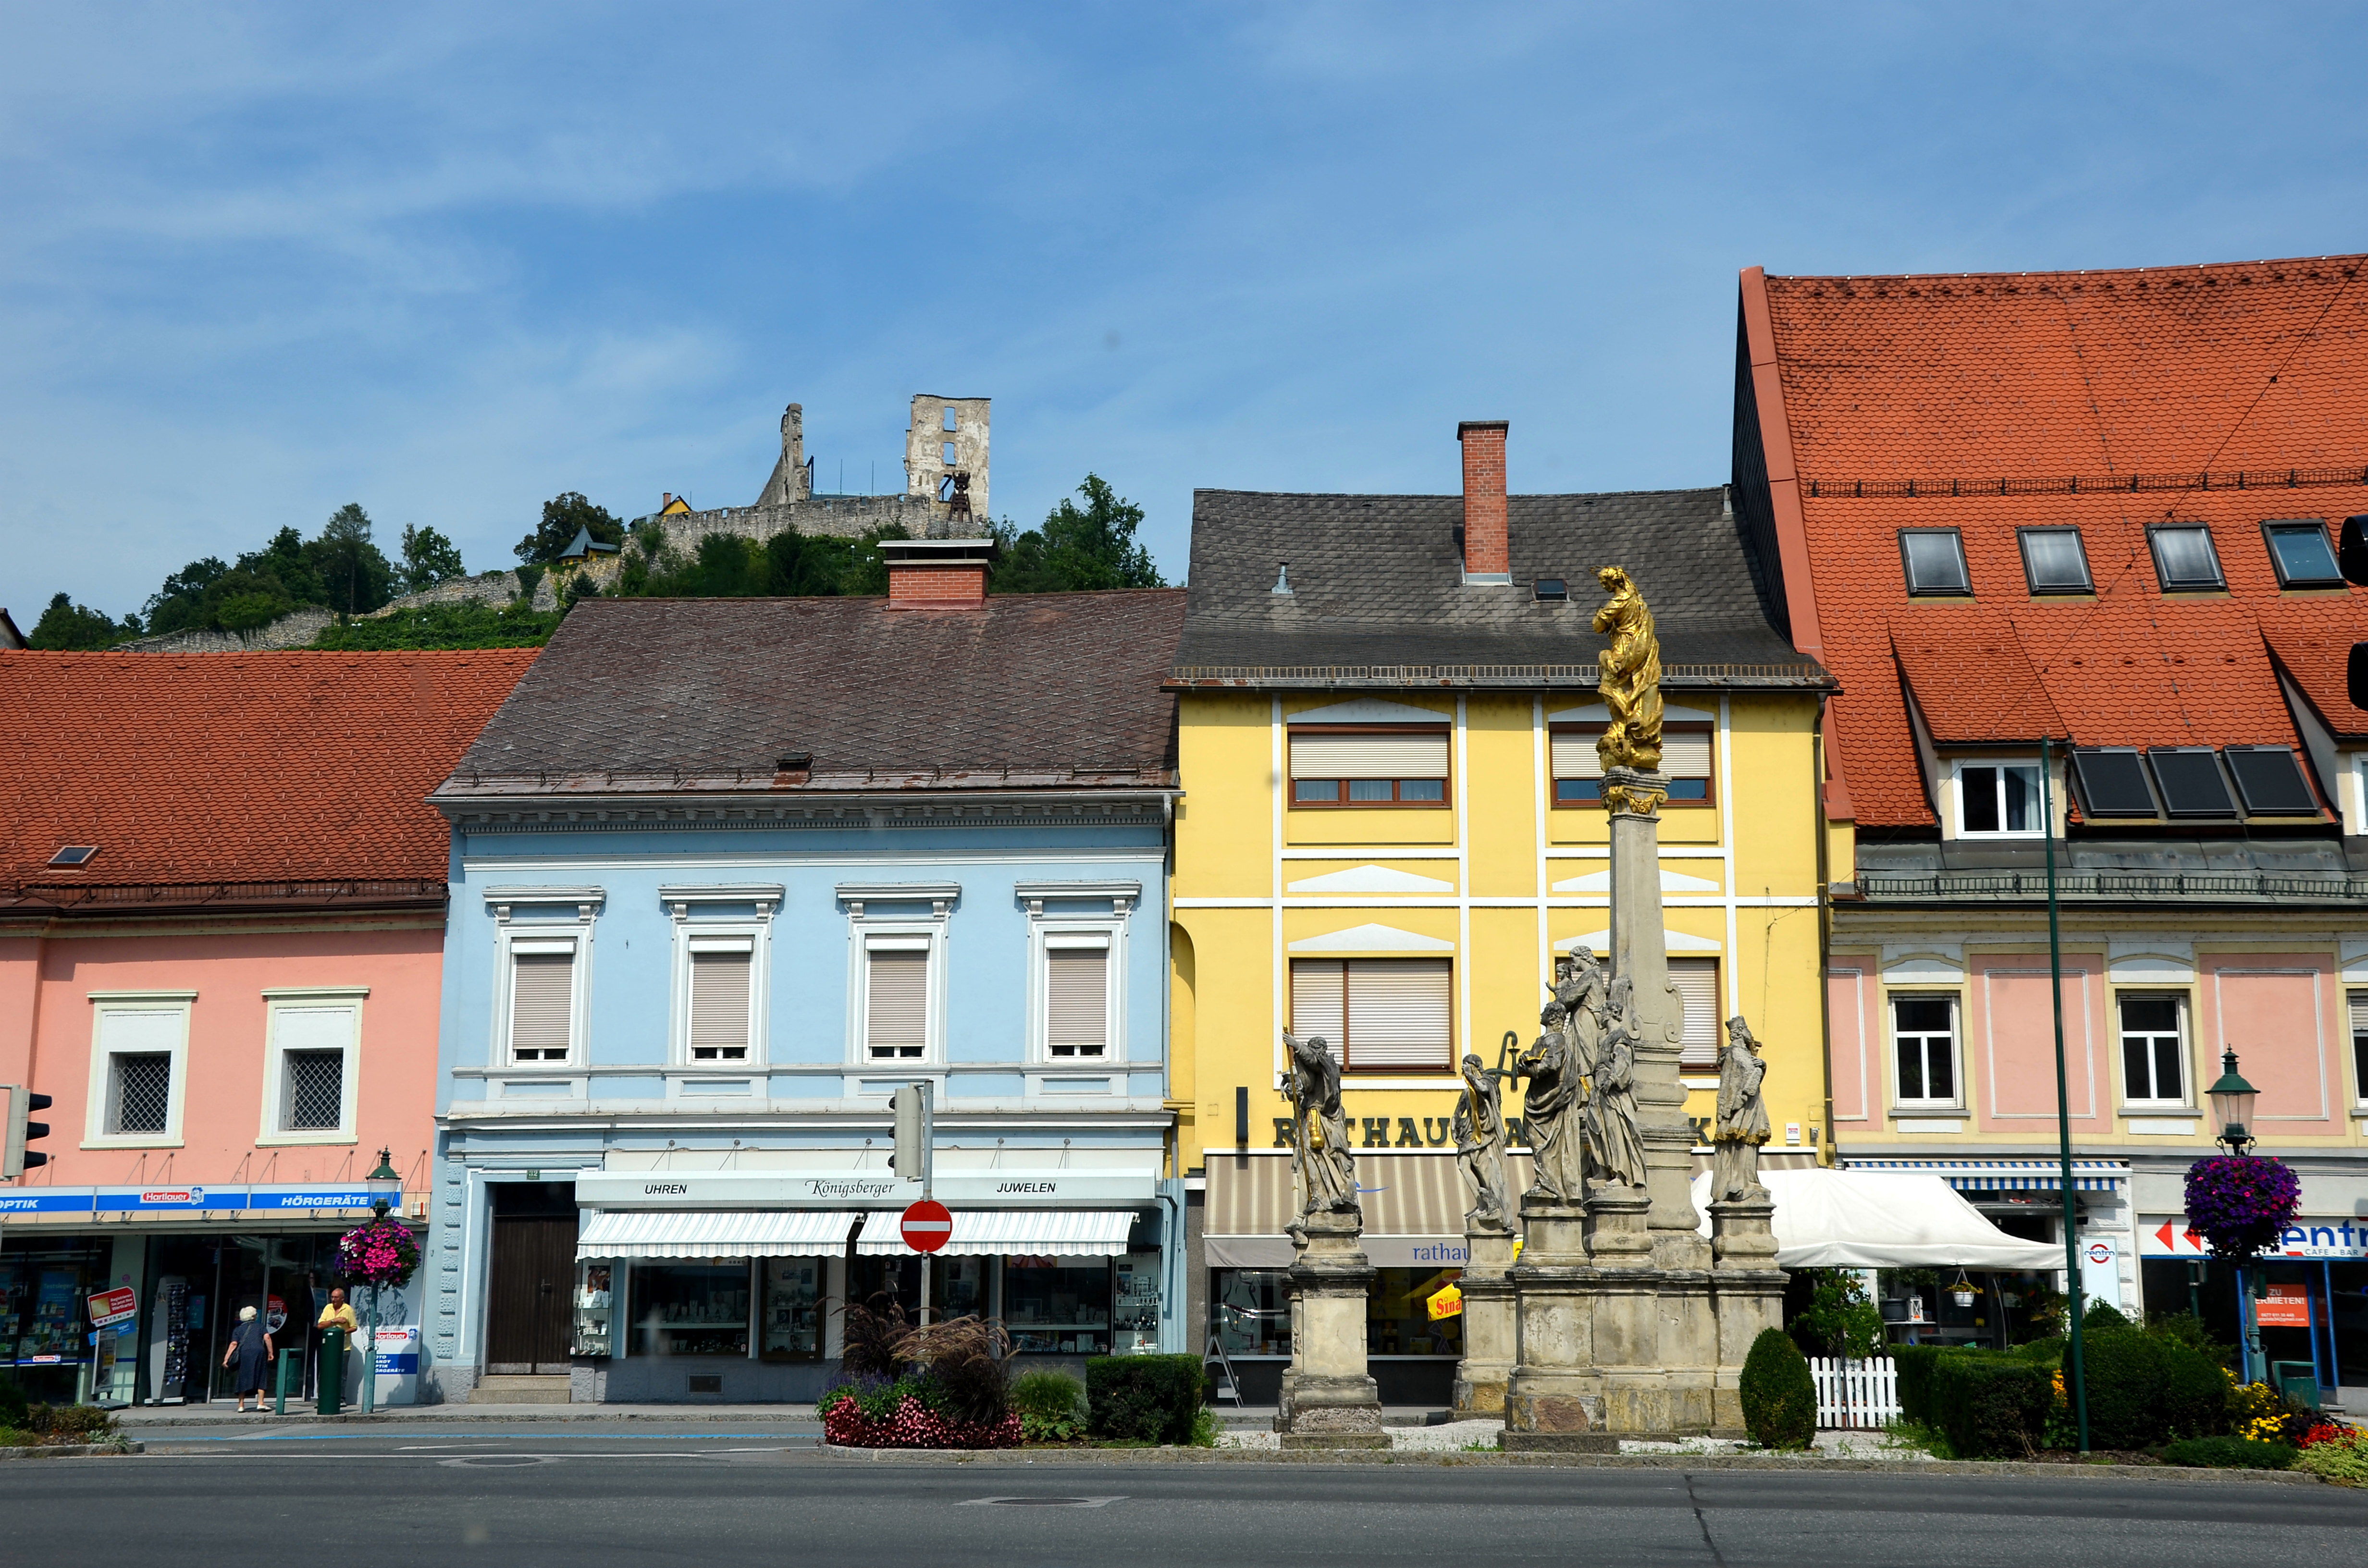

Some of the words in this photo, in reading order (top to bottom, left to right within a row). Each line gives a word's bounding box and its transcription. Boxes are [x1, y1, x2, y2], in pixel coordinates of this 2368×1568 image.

[645, 1184, 687, 1194] UHREN
[805, 1179, 895, 1198] Königsberger
[997, 1183, 1056, 1192] JUWELEN
[146, 1192, 187, 1201] Hartlauer
[281, 1195, 369, 1206] HÖRGERÄTE
[1436, 1297, 1462, 1315] Sina
